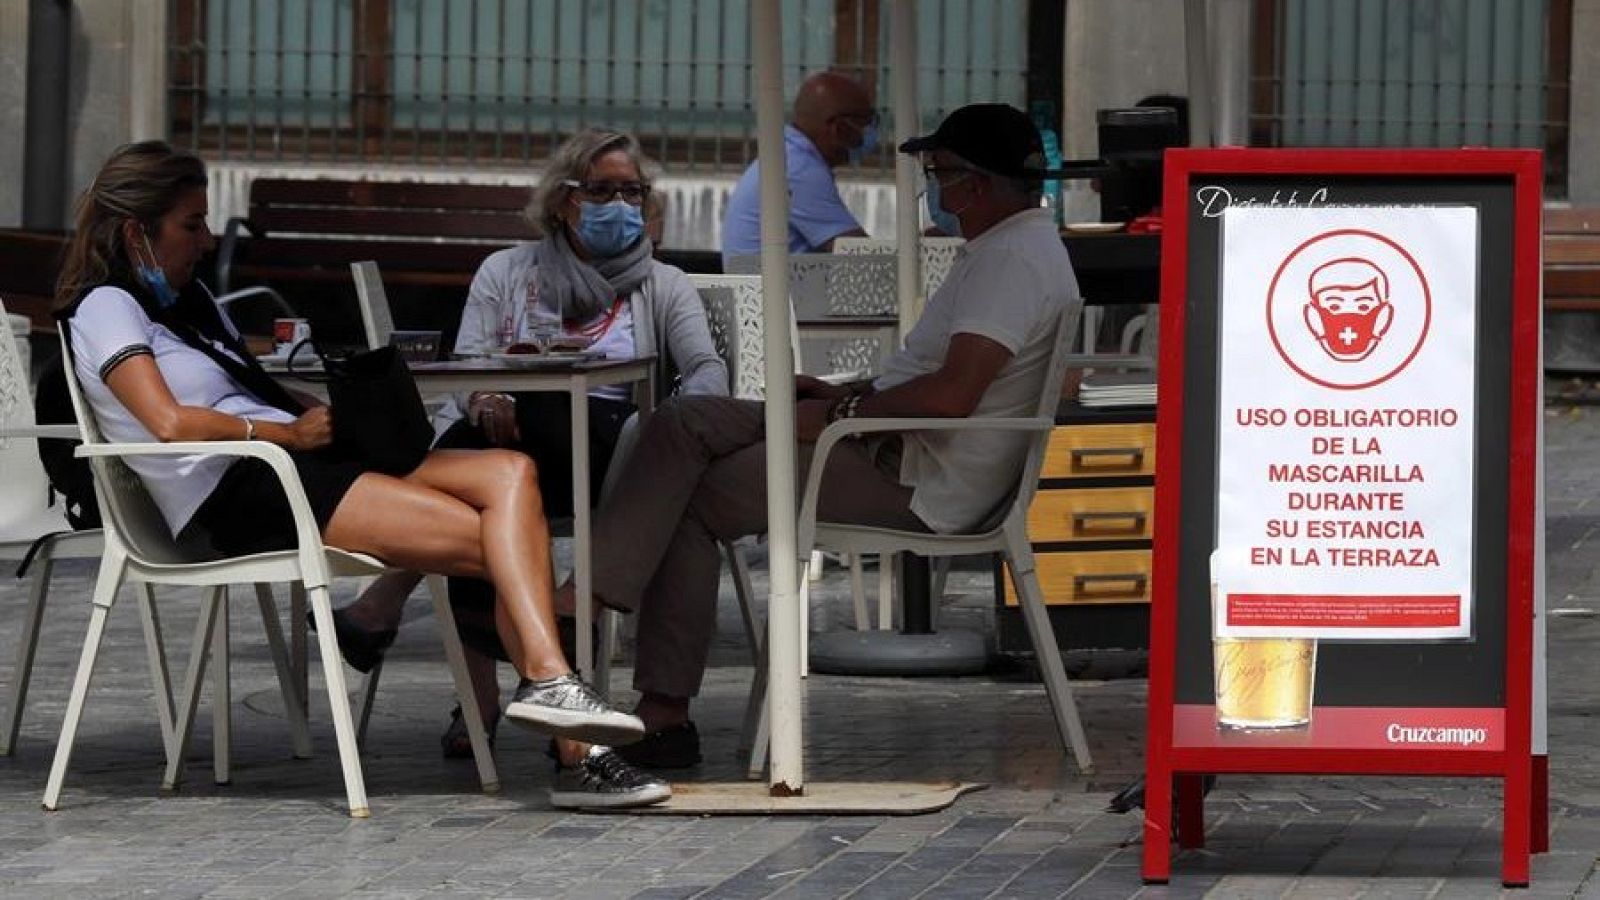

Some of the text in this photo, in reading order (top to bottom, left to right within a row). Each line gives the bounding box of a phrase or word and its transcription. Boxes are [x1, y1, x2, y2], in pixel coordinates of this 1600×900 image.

[1237, 408, 1458, 428] USO OBLIGATORIO
[1312, 437, 1382, 455] DE LA
[1268, 464, 1425, 482] MASCARILLA
[1288, 492, 1404, 511] DURANTE
[1266, 519, 1425, 539] SU ESTANCIA
[1251, 547, 1440, 567] EN LA TERRAZA
[1387, 723, 1487, 746] Cruzcampo
